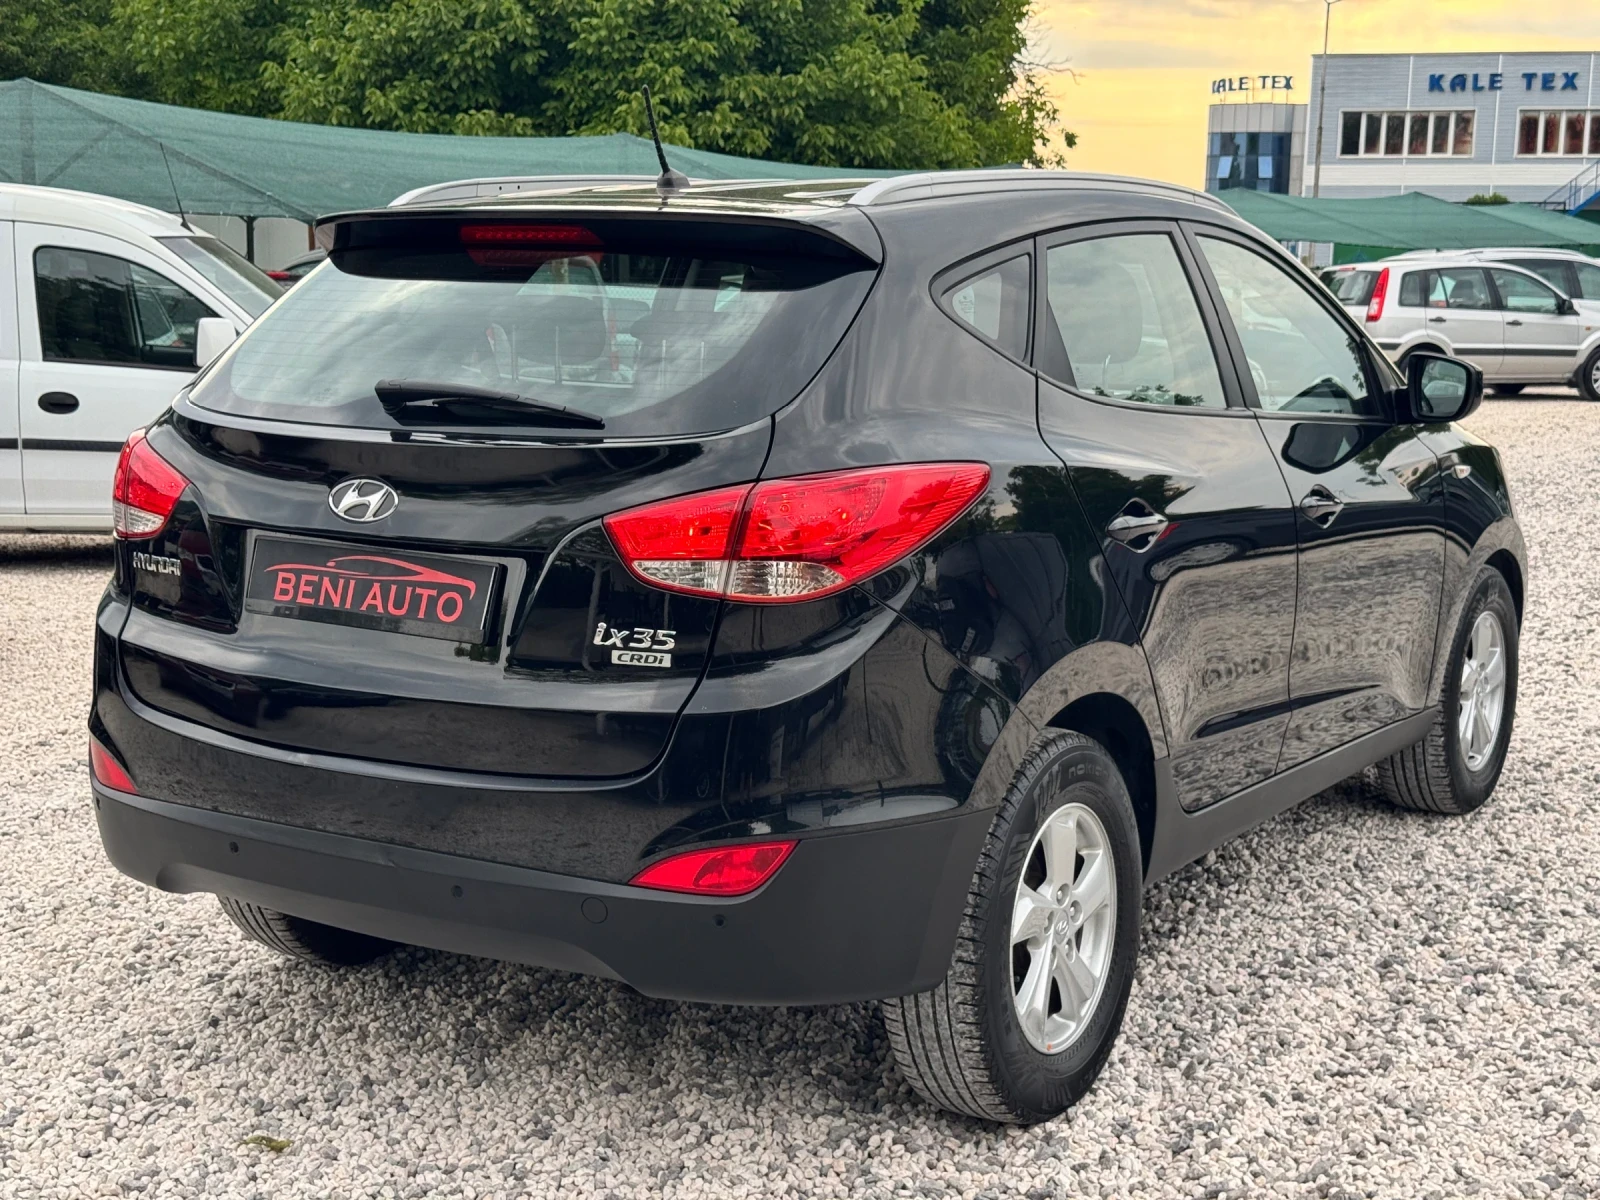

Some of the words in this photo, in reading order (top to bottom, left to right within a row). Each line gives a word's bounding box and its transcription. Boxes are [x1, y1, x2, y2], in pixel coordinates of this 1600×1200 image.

[1258, 76, 1294, 90] TEX
[1428, 73, 1503, 92] KALE
[1522, 72, 1579, 91] TEX
[133, 551, 181, 577] HYUNDAI
[273, 571, 356, 609] BENI
[359, 582, 463, 623] AUTO
[593, 622, 676, 650] ix35
[617, 653, 665, 665] CRDi
